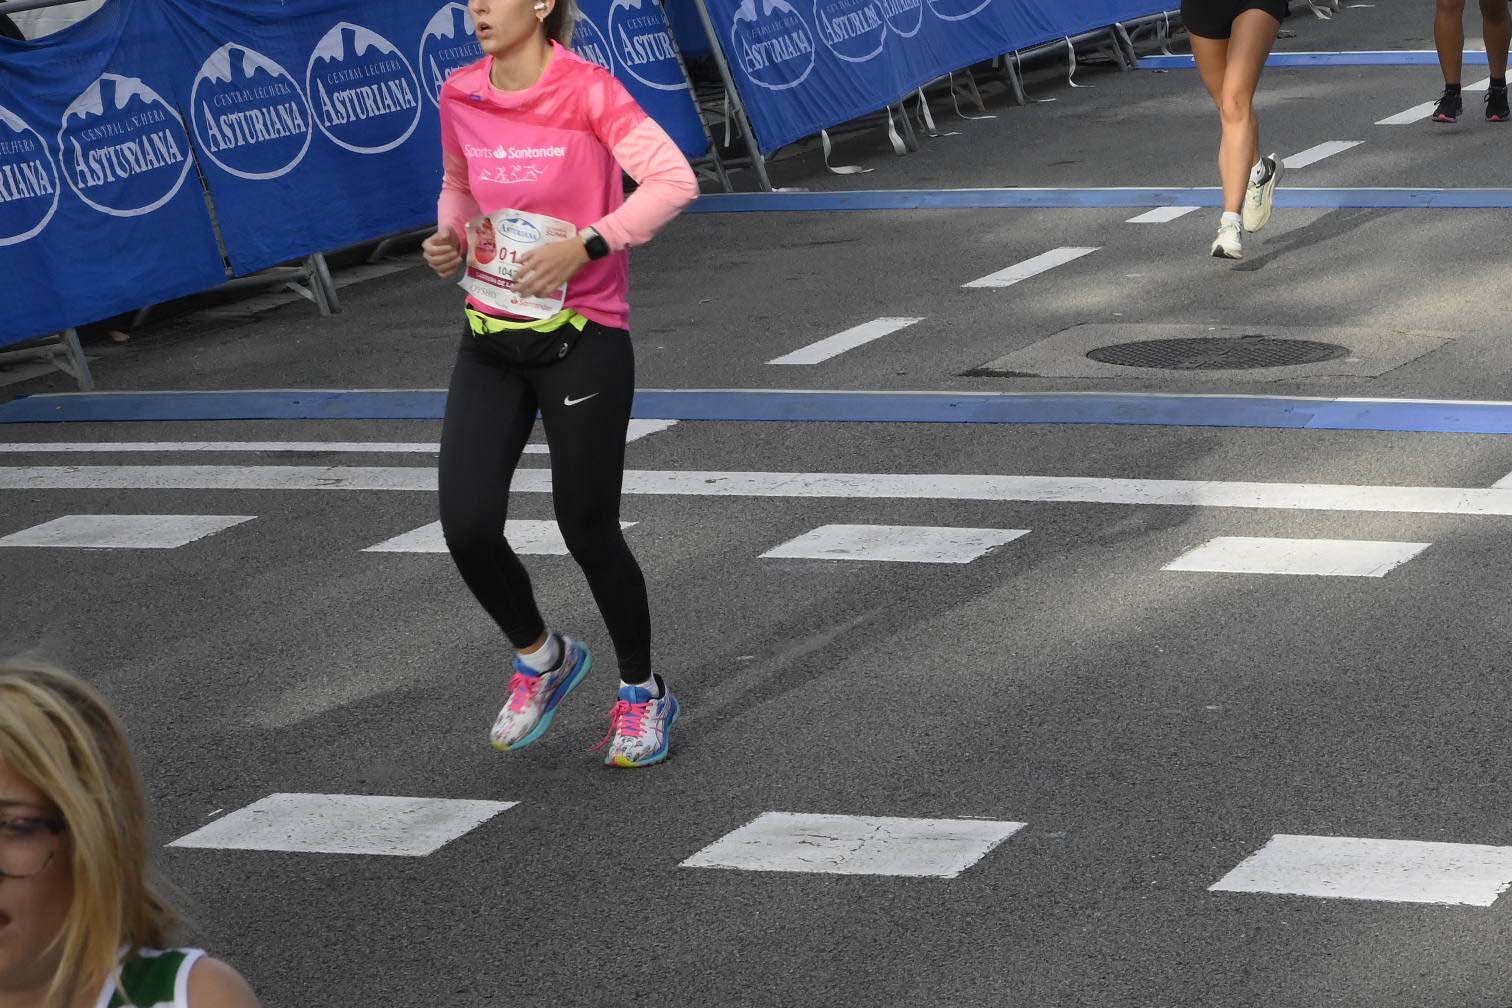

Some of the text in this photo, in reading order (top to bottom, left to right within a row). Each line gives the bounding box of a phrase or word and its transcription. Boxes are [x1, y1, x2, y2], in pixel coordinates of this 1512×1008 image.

[364, 61, 401, 79] LECHERA
[316, 77, 416, 129] ASTURIANA
[202, 99, 306, 152] ASTURIANA
[464, 144, 568, 160] Sports Santander
